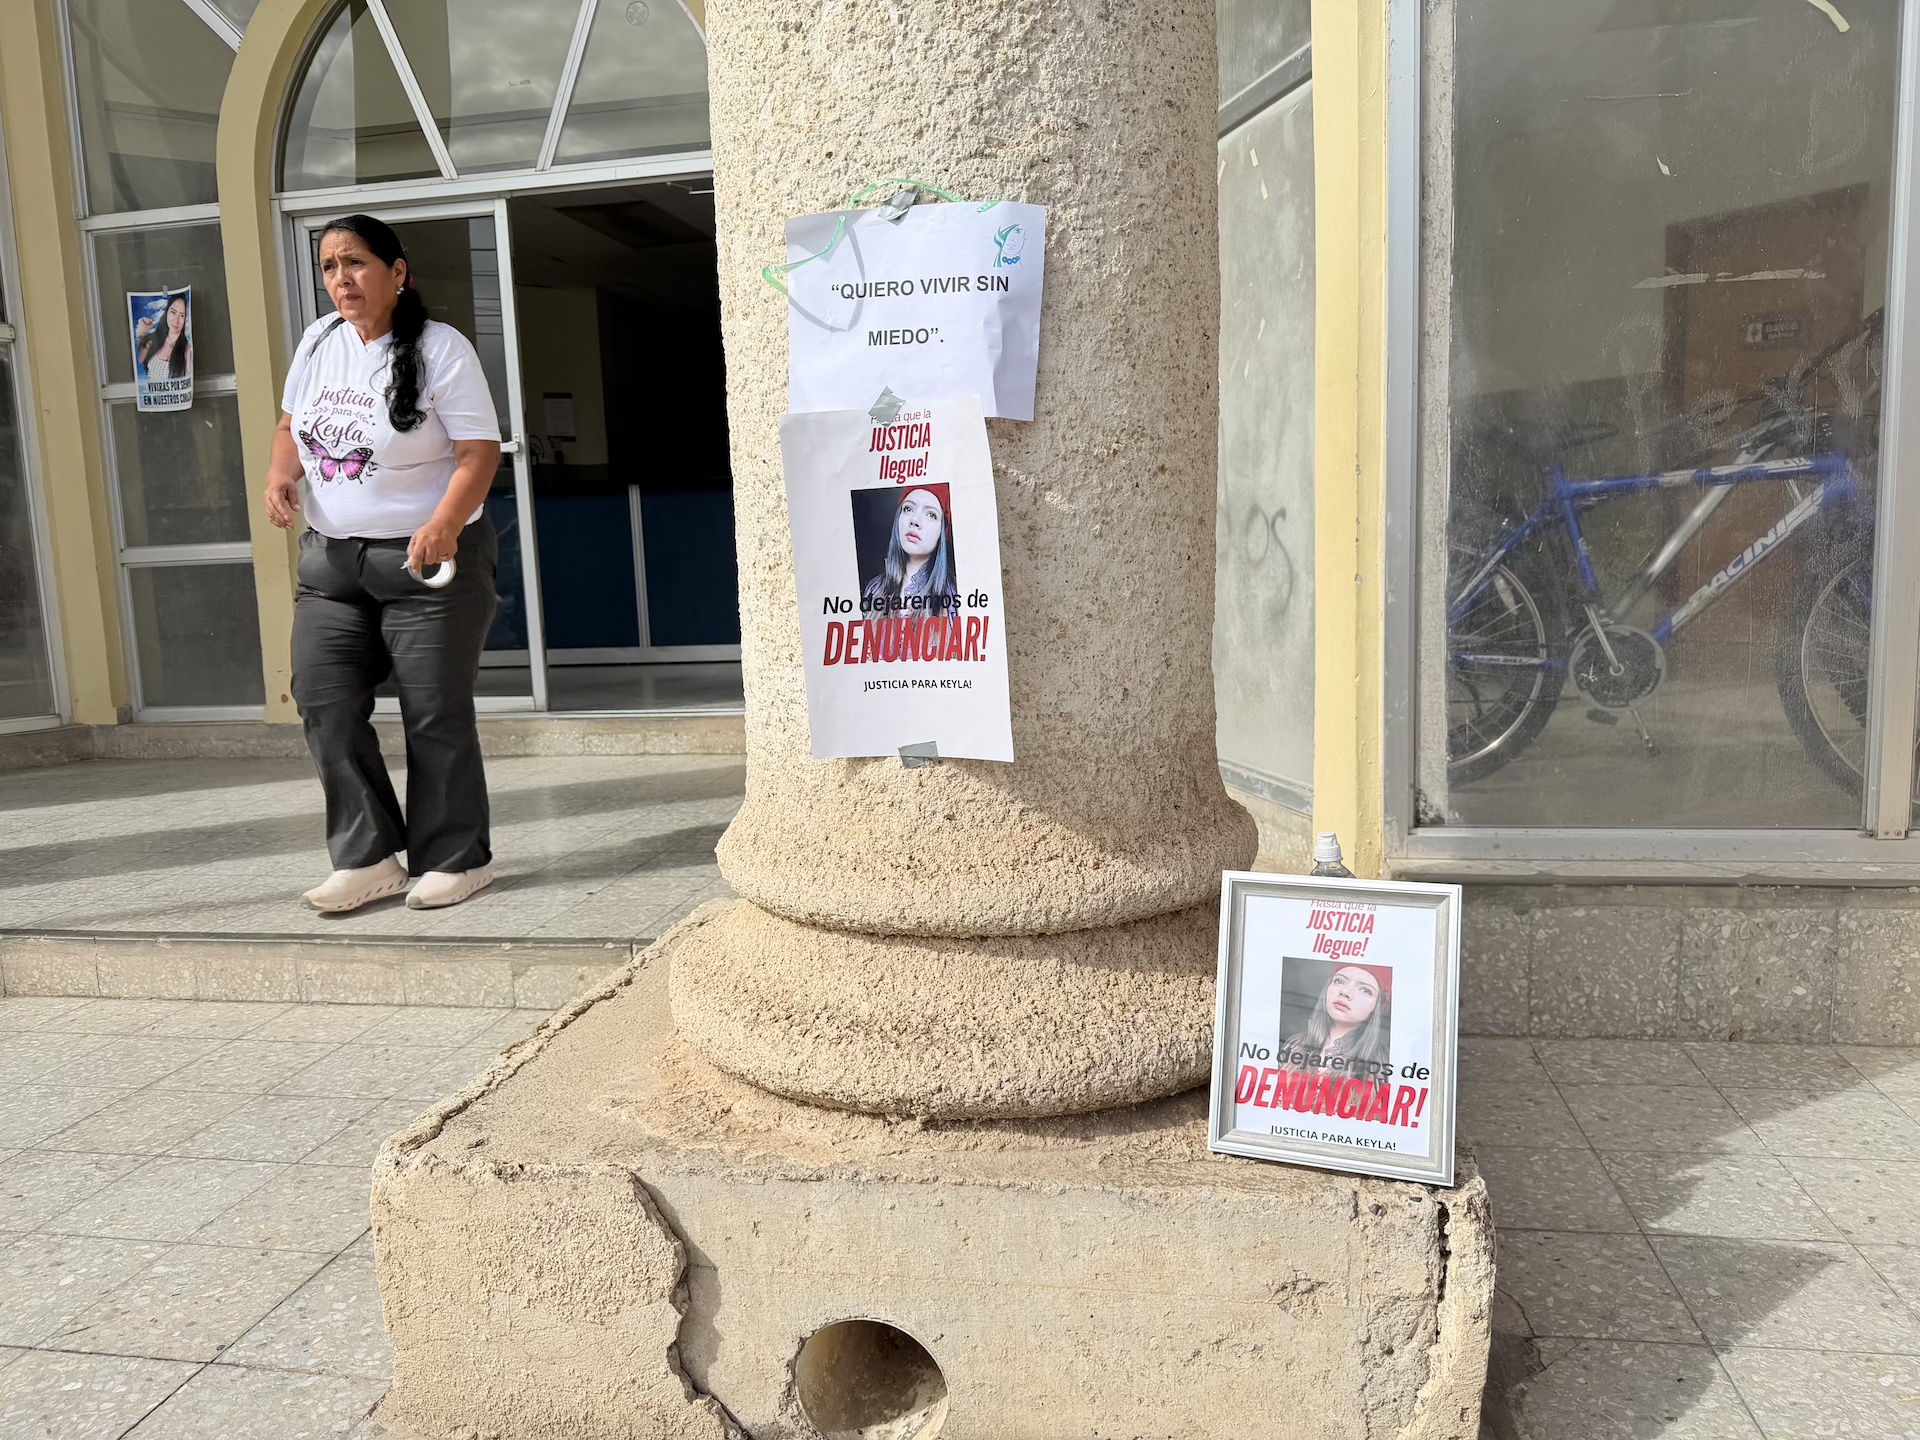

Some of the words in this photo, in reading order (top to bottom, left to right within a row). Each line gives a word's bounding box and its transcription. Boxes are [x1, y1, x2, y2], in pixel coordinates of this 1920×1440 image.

[831, 280, 914, 300] “QUIERO
[920, 276, 970, 295] VIVIR
[976, 275, 1009, 292] SIN
[868, 327, 944, 346] MIEDO”.
[148, 382, 169, 392] VIVIRAS
[170, 381, 180, 391] POR
[312, 385, 376, 409] justicia
[144, 395, 152, 405] EN
[153, 394, 179, 405] NUESTROS
[331, 407, 352, 416] para
[903, 411, 921, 423] que
[923, 408, 931, 419] la
[311, 415, 366, 448] Keyla
[869, 422, 930, 452] JUSTICIA
[879, 451, 929, 484] llegue!
[823, 596, 853, 614] No
[859, 592, 961, 616] dejaremos
[967, 588, 989, 608] de
[823, 615, 989, 666] DENUNCIAR!
[864, 680, 908, 692] JUSTICIA
[911, 679, 937, 689] PARA
[940, 679, 972, 689] KEYLA!
[1345, 902, 1365, 911] que
[1305, 909, 1375, 934] JUSTICIA
[1312, 933, 1369, 960] llegue!
[1239, 1042, 1270, 1061] No
[1276, 1046, 1394, 1077] dejaremos
[1401, 1062, 1430, 1081] de
[1235, 1065, 1428, 1128] DENUNCIAR!
[1270, 1125, 1318, 1140] JUSTICIA
[1321, 1132, 1352, 1145] PARA
[1356, 1138, 1397, 1151] KEYLA!
